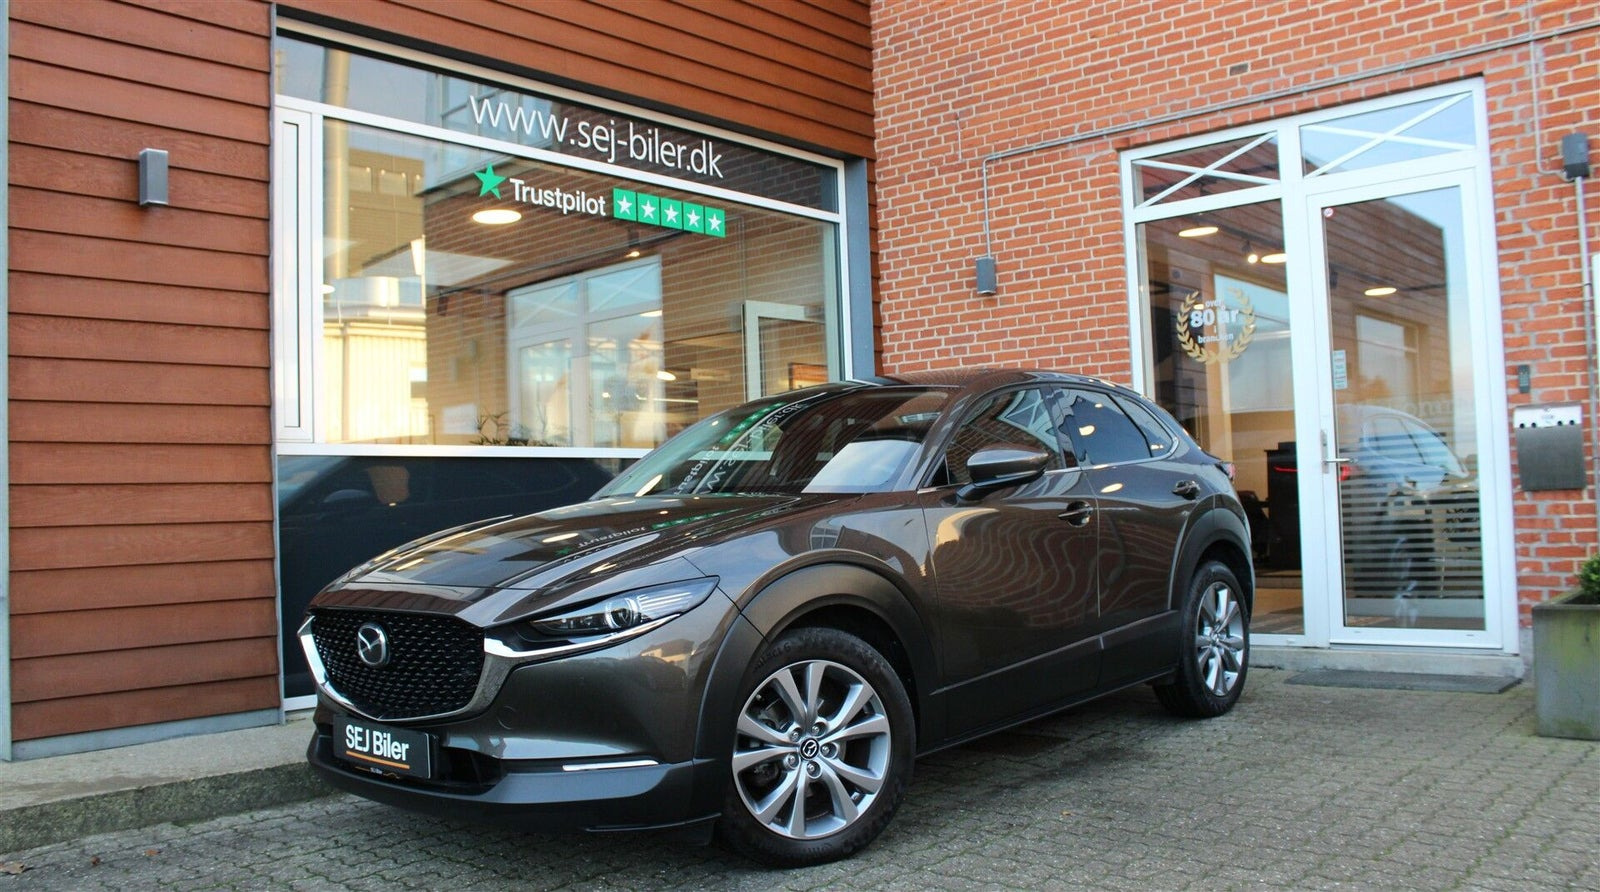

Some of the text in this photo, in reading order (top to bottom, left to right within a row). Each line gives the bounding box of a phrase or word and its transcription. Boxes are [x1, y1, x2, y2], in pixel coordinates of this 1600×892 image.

[470, 95, 724, 179] www.sej-biler.dk
[509, 178, 606, 216] Trustpilot
[1190, 305, 1239, 327] 80 år
[345, 724, 410, 761] SEJ Biler
